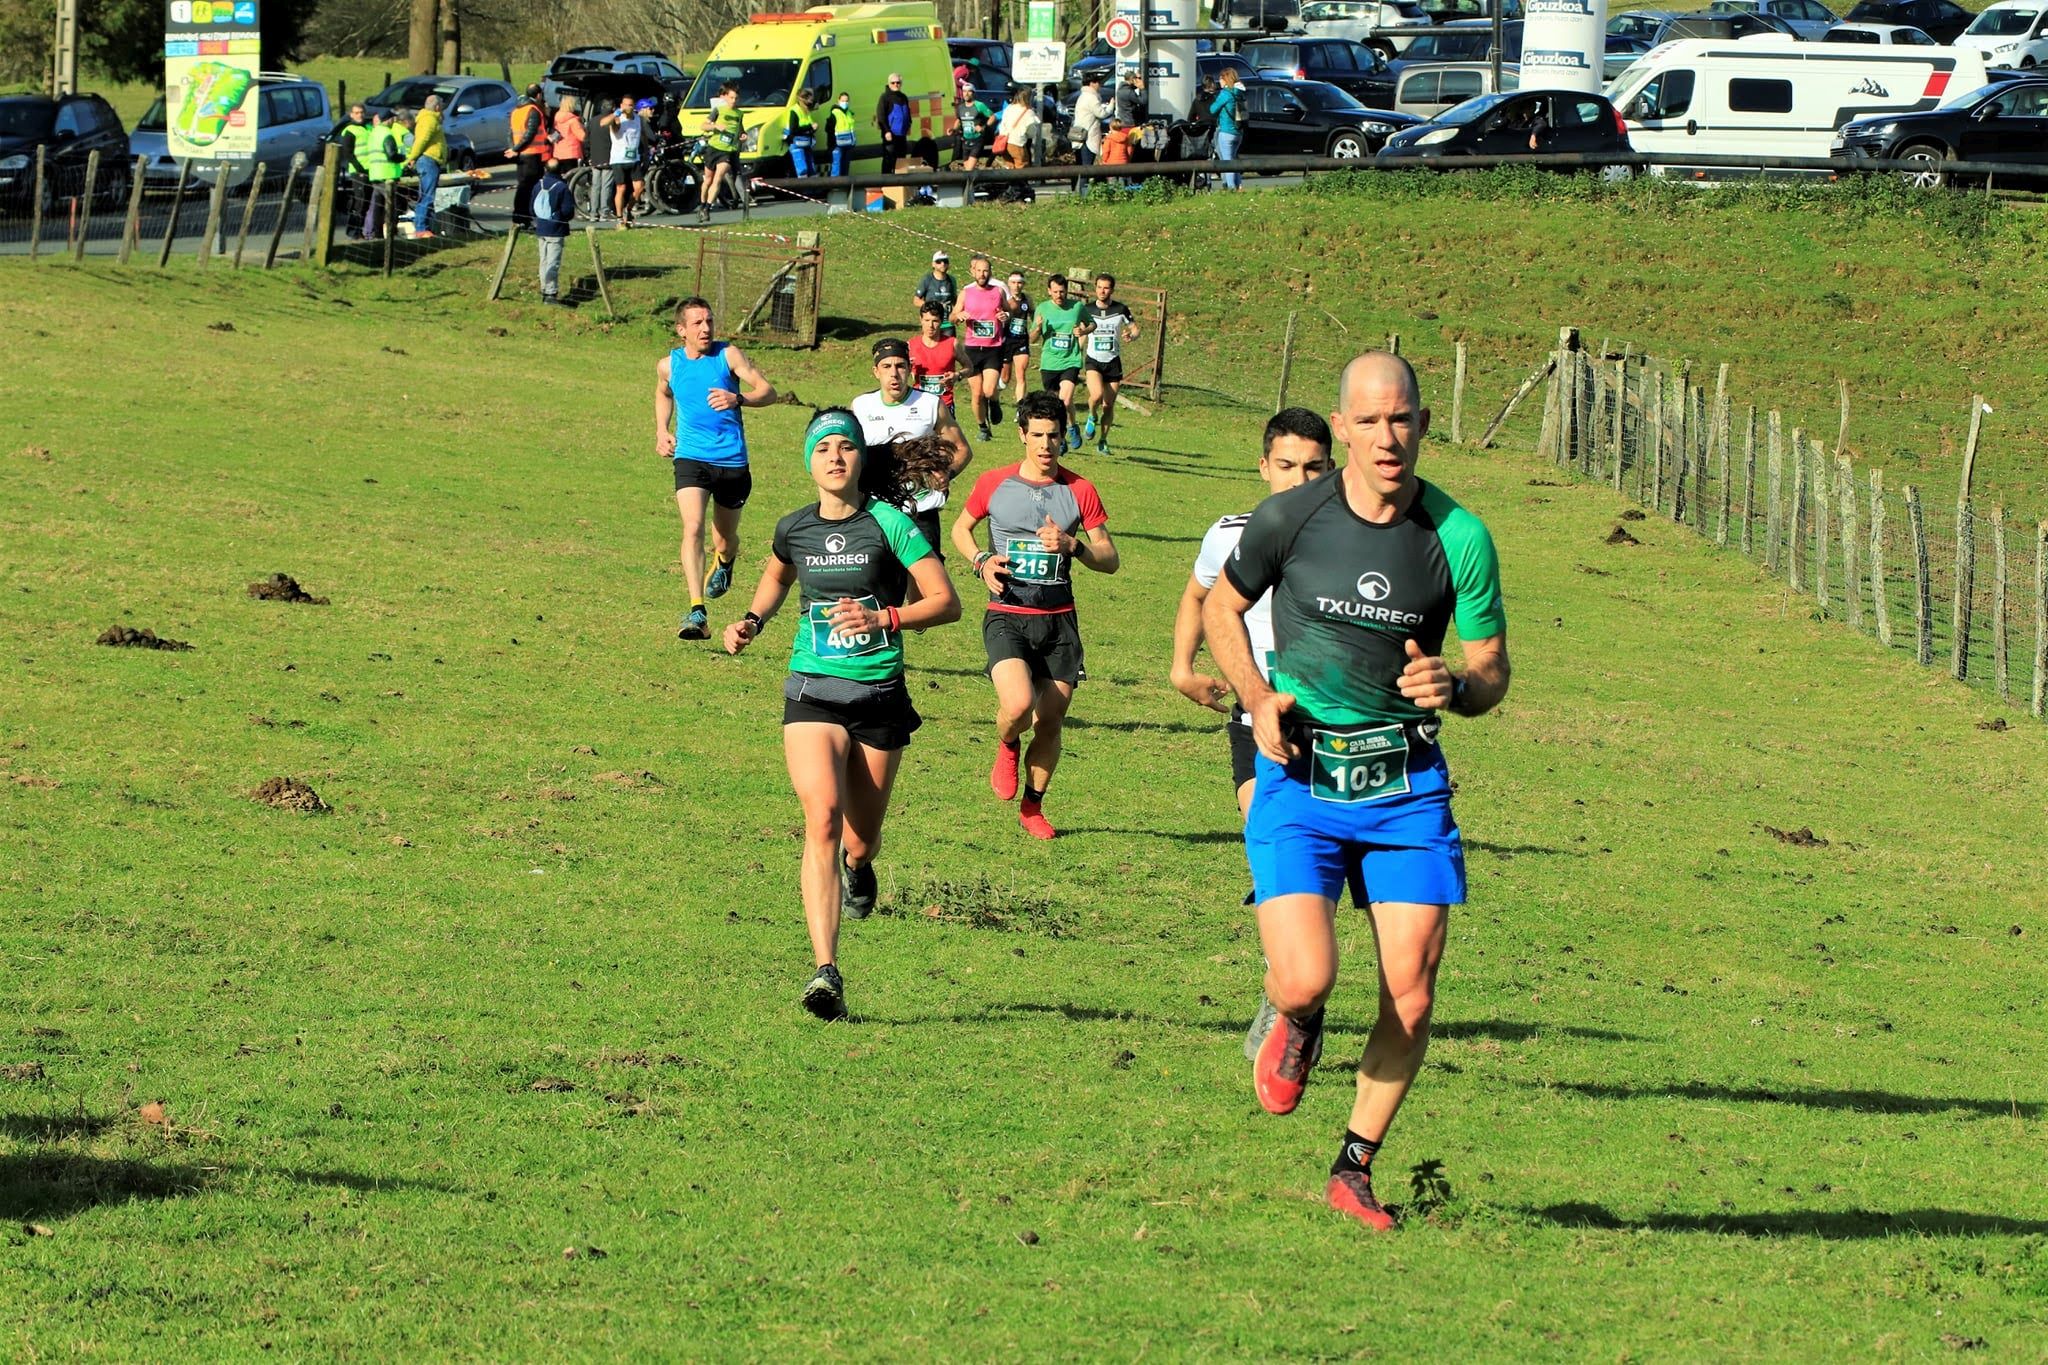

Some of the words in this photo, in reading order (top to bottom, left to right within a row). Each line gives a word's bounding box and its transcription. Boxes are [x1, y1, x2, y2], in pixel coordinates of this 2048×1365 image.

[1528, 0, 1583, 14] Gipuzkoa
[1524, 51, 1579, 67] Gipuzkoa
[805, 553, 869, 566] TXURREGI
[1015, 557, 1049, 576] 215
[1316, 596, 1424, 626] TXURREGI
[1331, 761, 1387, 792] 103
